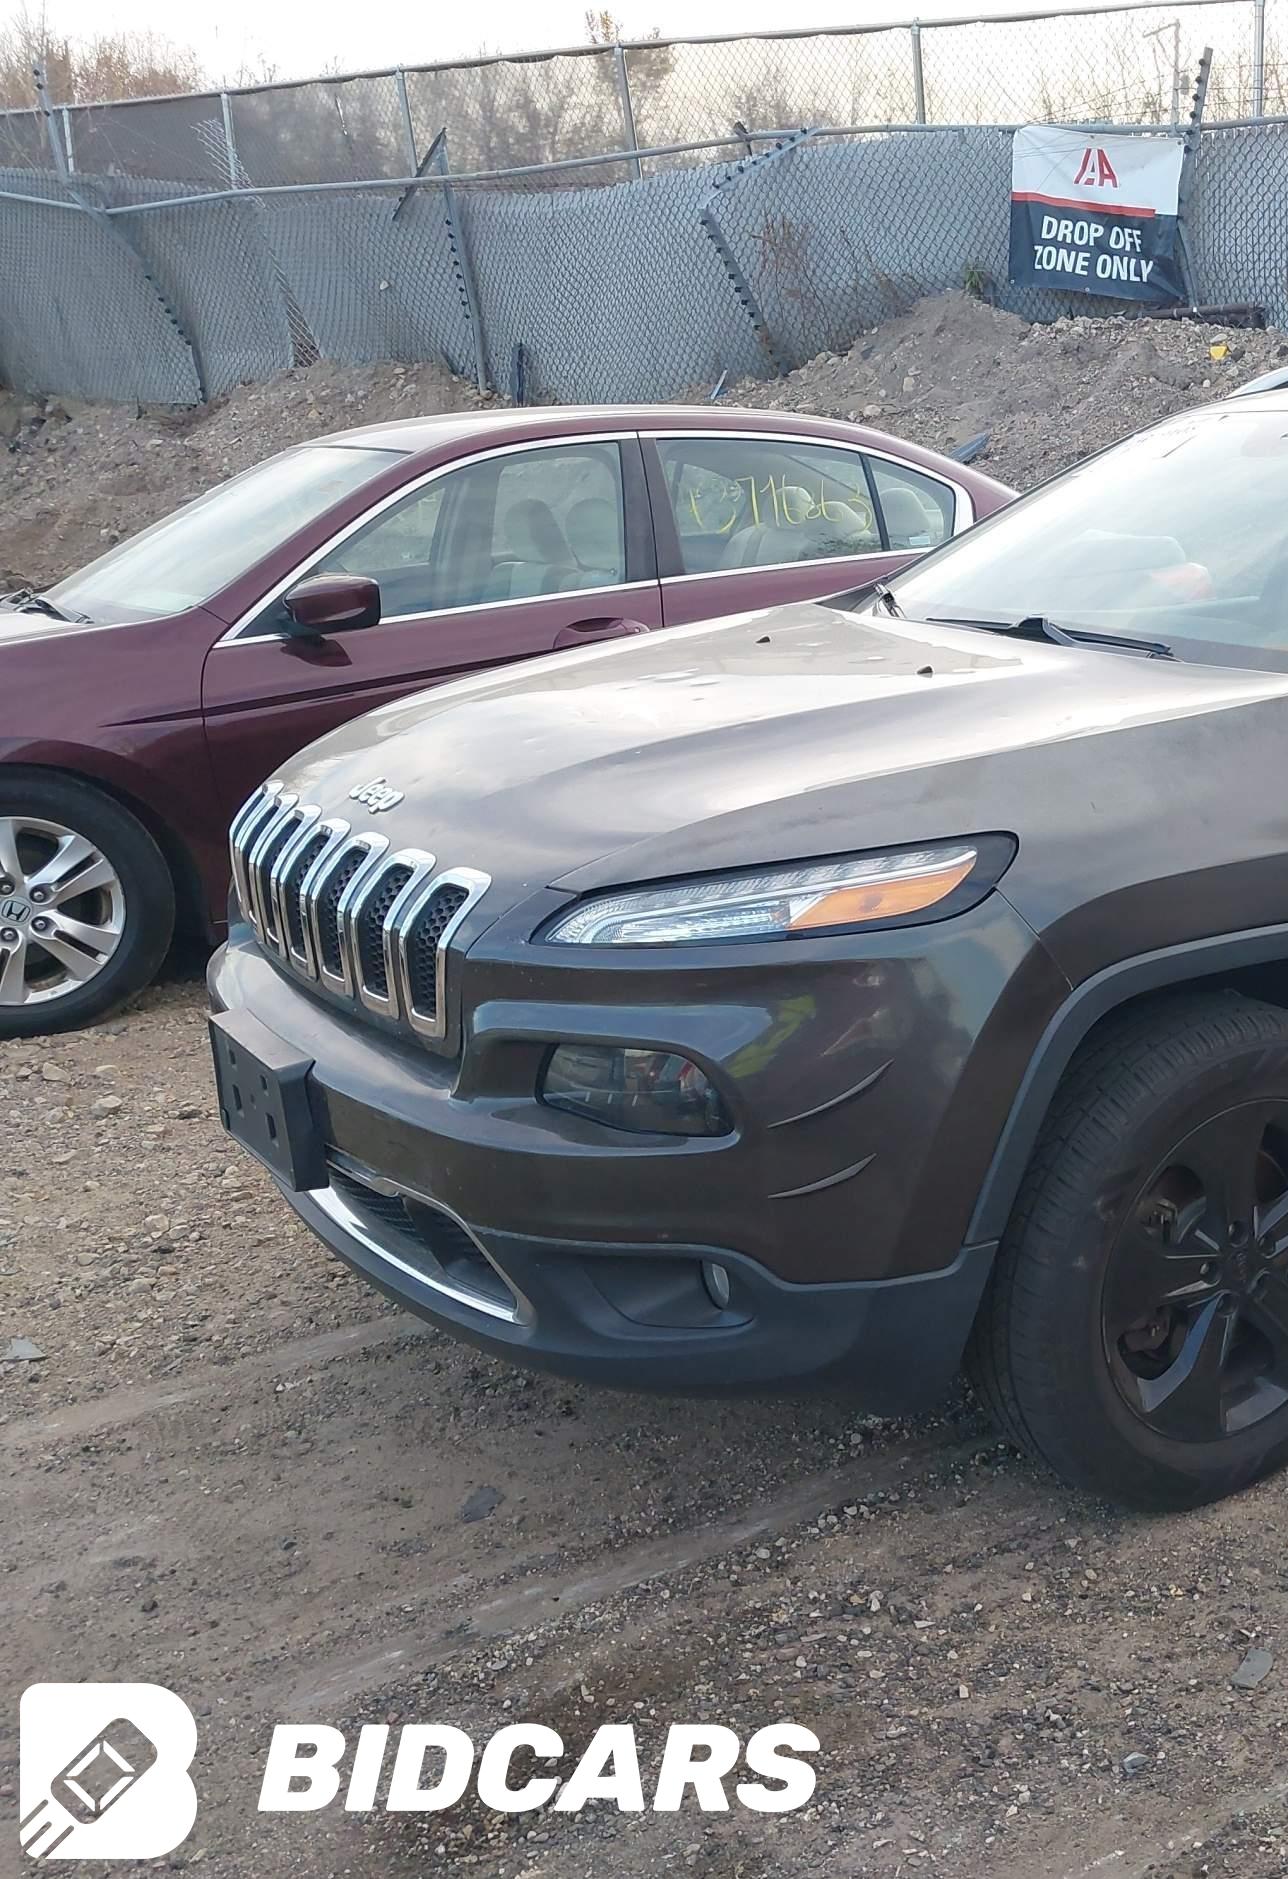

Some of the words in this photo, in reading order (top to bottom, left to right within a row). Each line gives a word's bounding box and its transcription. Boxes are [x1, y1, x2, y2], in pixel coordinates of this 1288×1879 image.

[1041, 215, 1105, 247] DROP
[1109, 226, 1142, 253] OFF
[1034, 245, 1091, 277] ZONE
[1096, 254, 1154, 283] ONLY
[348, 776, 405, 815] Jeep
